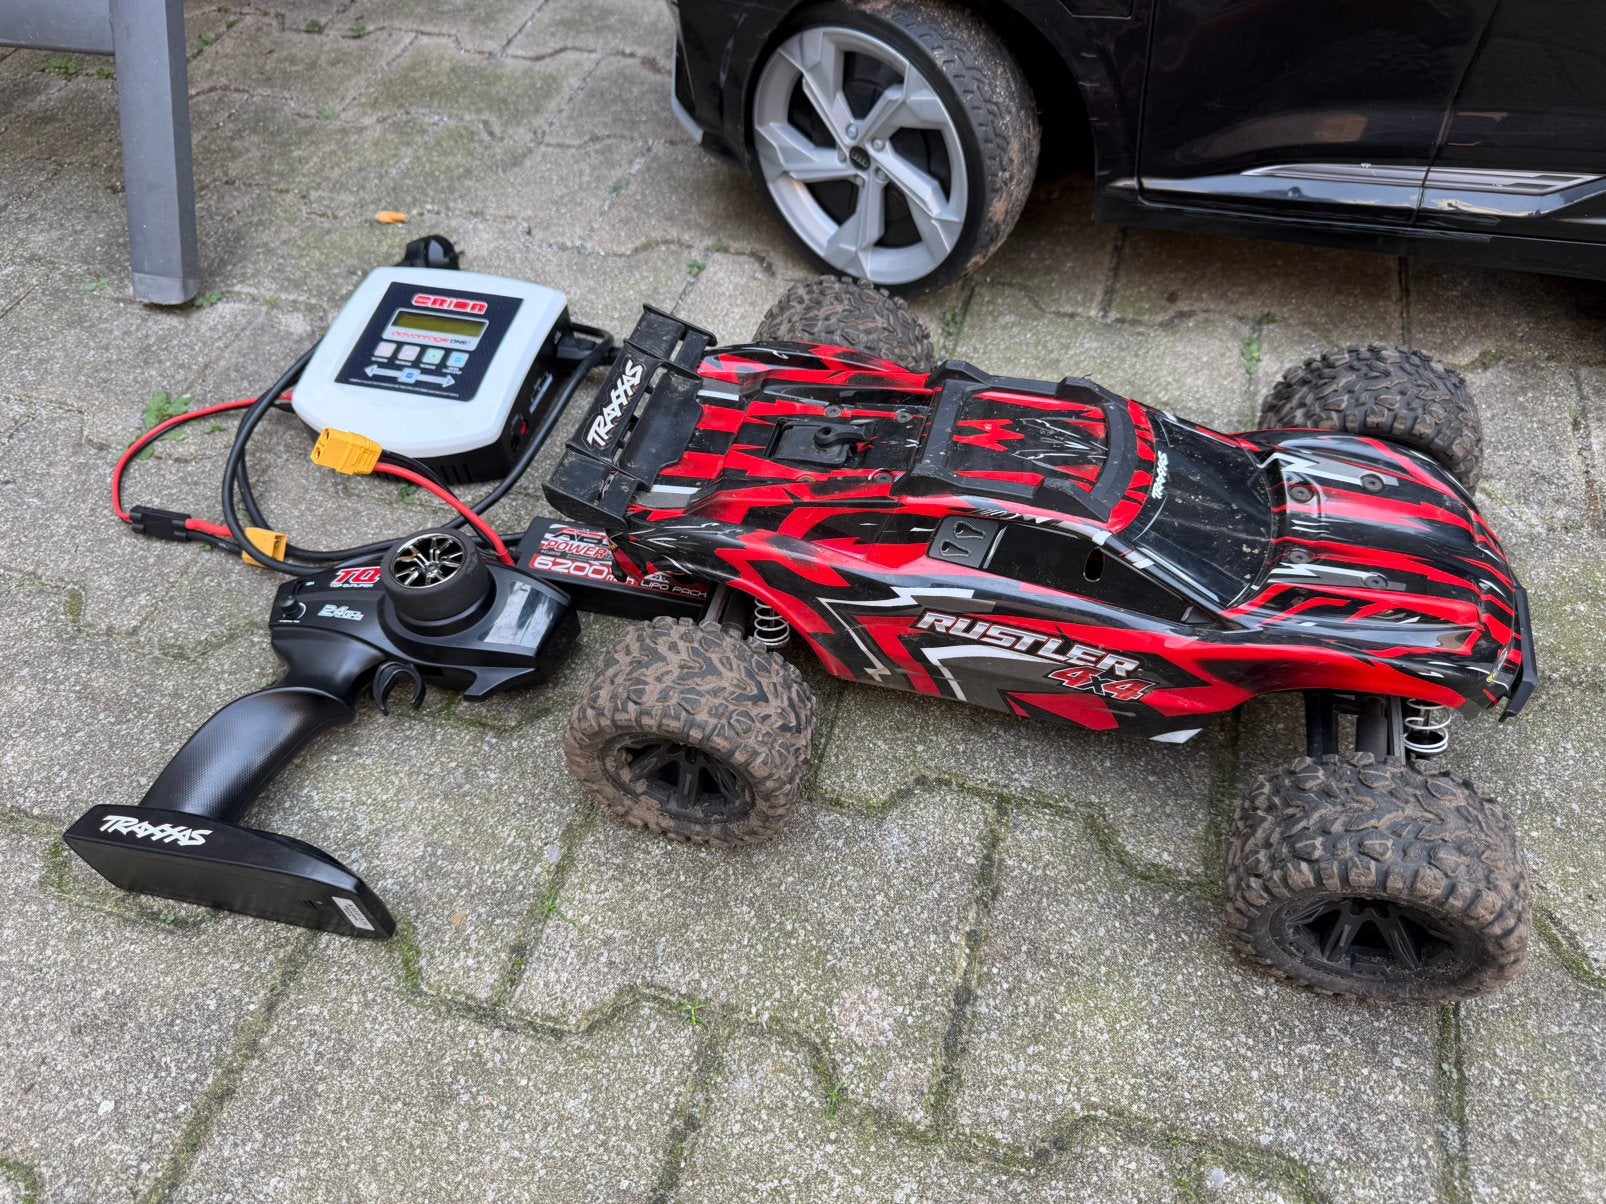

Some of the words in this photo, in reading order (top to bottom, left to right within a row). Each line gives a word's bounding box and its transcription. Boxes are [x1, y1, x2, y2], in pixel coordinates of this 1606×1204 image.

[586, 359, 643, 448] TRAXXAS
[1152, 450, 1169, 499] TRAXXAS
[542, 539, 608, 560] POWER
[333, 566, 382, 585] TQ
[533, 555, 609, 580] 6200
[640, 580, 670, 591] LIPO
[672, 587, 708, 598] PACK
[916, 612, 1140, 677] RUSTLER
[100, 814, 213, 846] TRAXXAS
